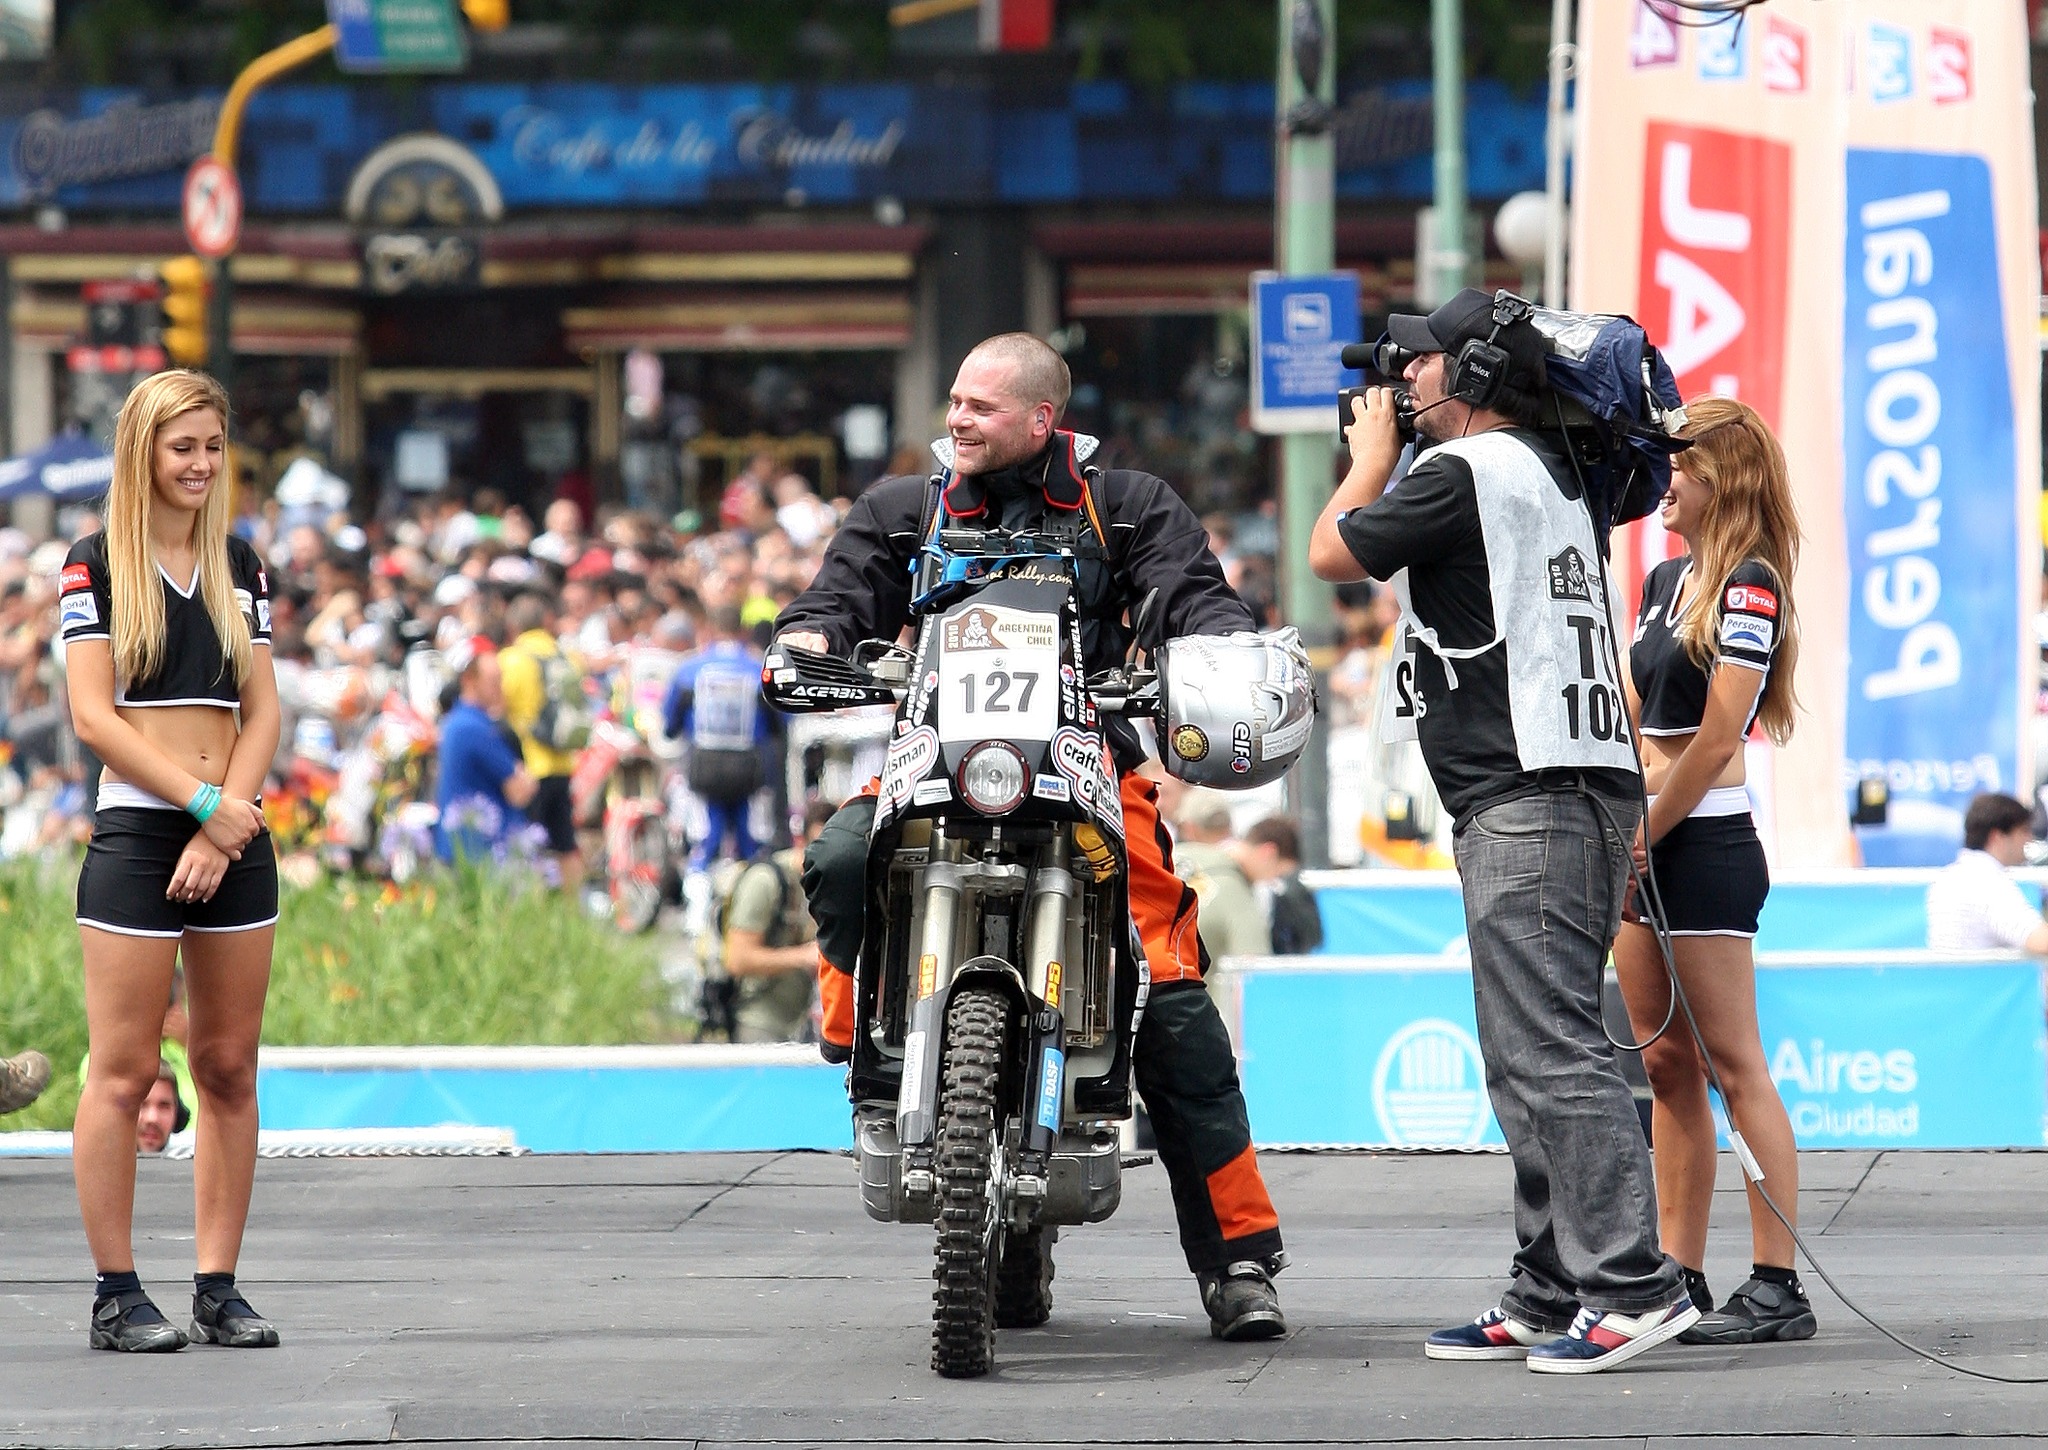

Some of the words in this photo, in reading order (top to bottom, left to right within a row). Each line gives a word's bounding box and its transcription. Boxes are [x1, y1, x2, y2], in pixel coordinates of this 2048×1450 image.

[1470, 361, 1491, 378] Telex
[60, 573, 87, 585] OTAL
[1551, 564, 1565, 594] 2010
[1747, 593, 1775, 609] TOTAL
[948, 624, 959, 649] 2010
[998, 623, 1053, 634] ARGENTINA
[1726, 618, 1769, 634] Personal
[1027, 636, 1053, 646] CHILE
[1070, 619, 1085, 689] HATSWELL
[791, 685, 867, 700] ACERBIS
[959, 671, 1039, 714] 127
[1078, 690, 1087, 724] RICK
[1771, 1037, 1919, 1094] Aires
[1045, 1059, 1059, 1098] BASF
[1791, 1101, 1920, 1138] Ciudad
